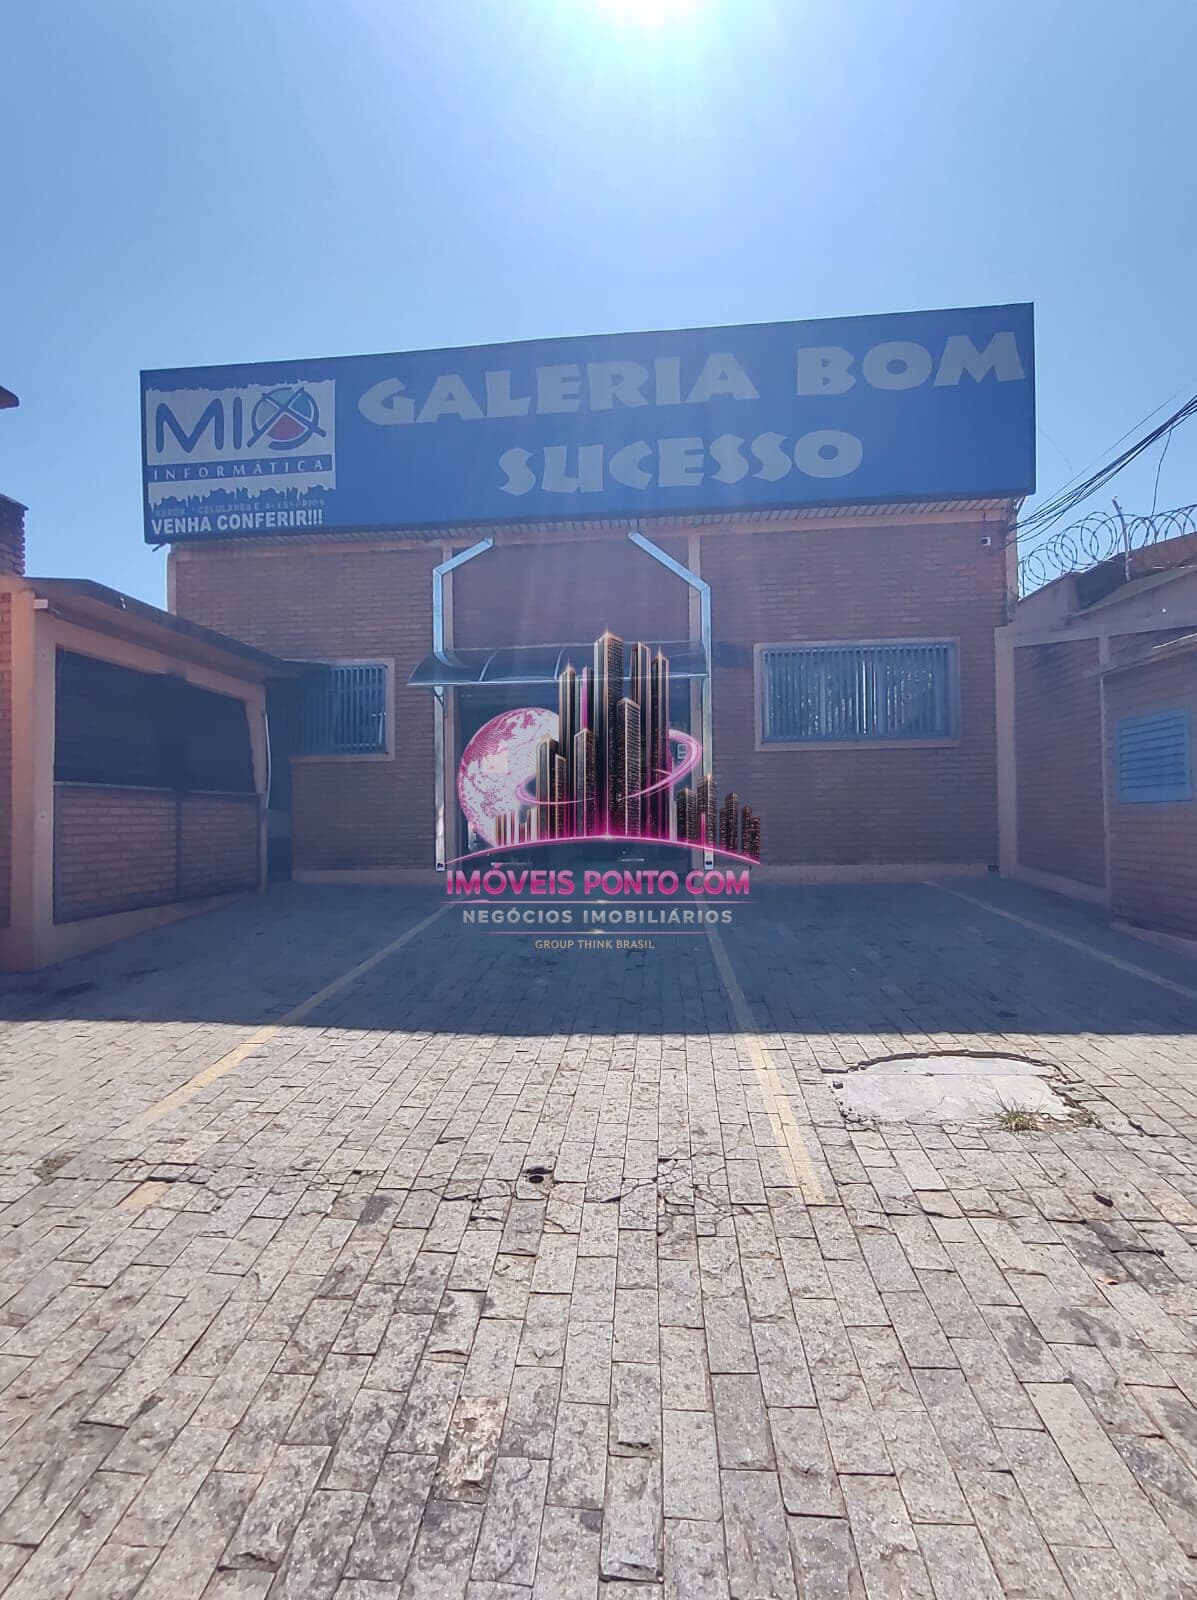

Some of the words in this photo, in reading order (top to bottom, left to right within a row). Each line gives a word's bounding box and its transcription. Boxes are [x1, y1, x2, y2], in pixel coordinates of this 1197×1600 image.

[357, 352, 760, 427] GALERIA
[796, 331, 1026, 398] BOM
[153, 459, 324, 481] INFORMÁTICA
[499, 430, 864, 497] SUCESSO
[151, 515, 212, 535] VENHA
[217, 509, 323, 531] CONFERIR!!!
